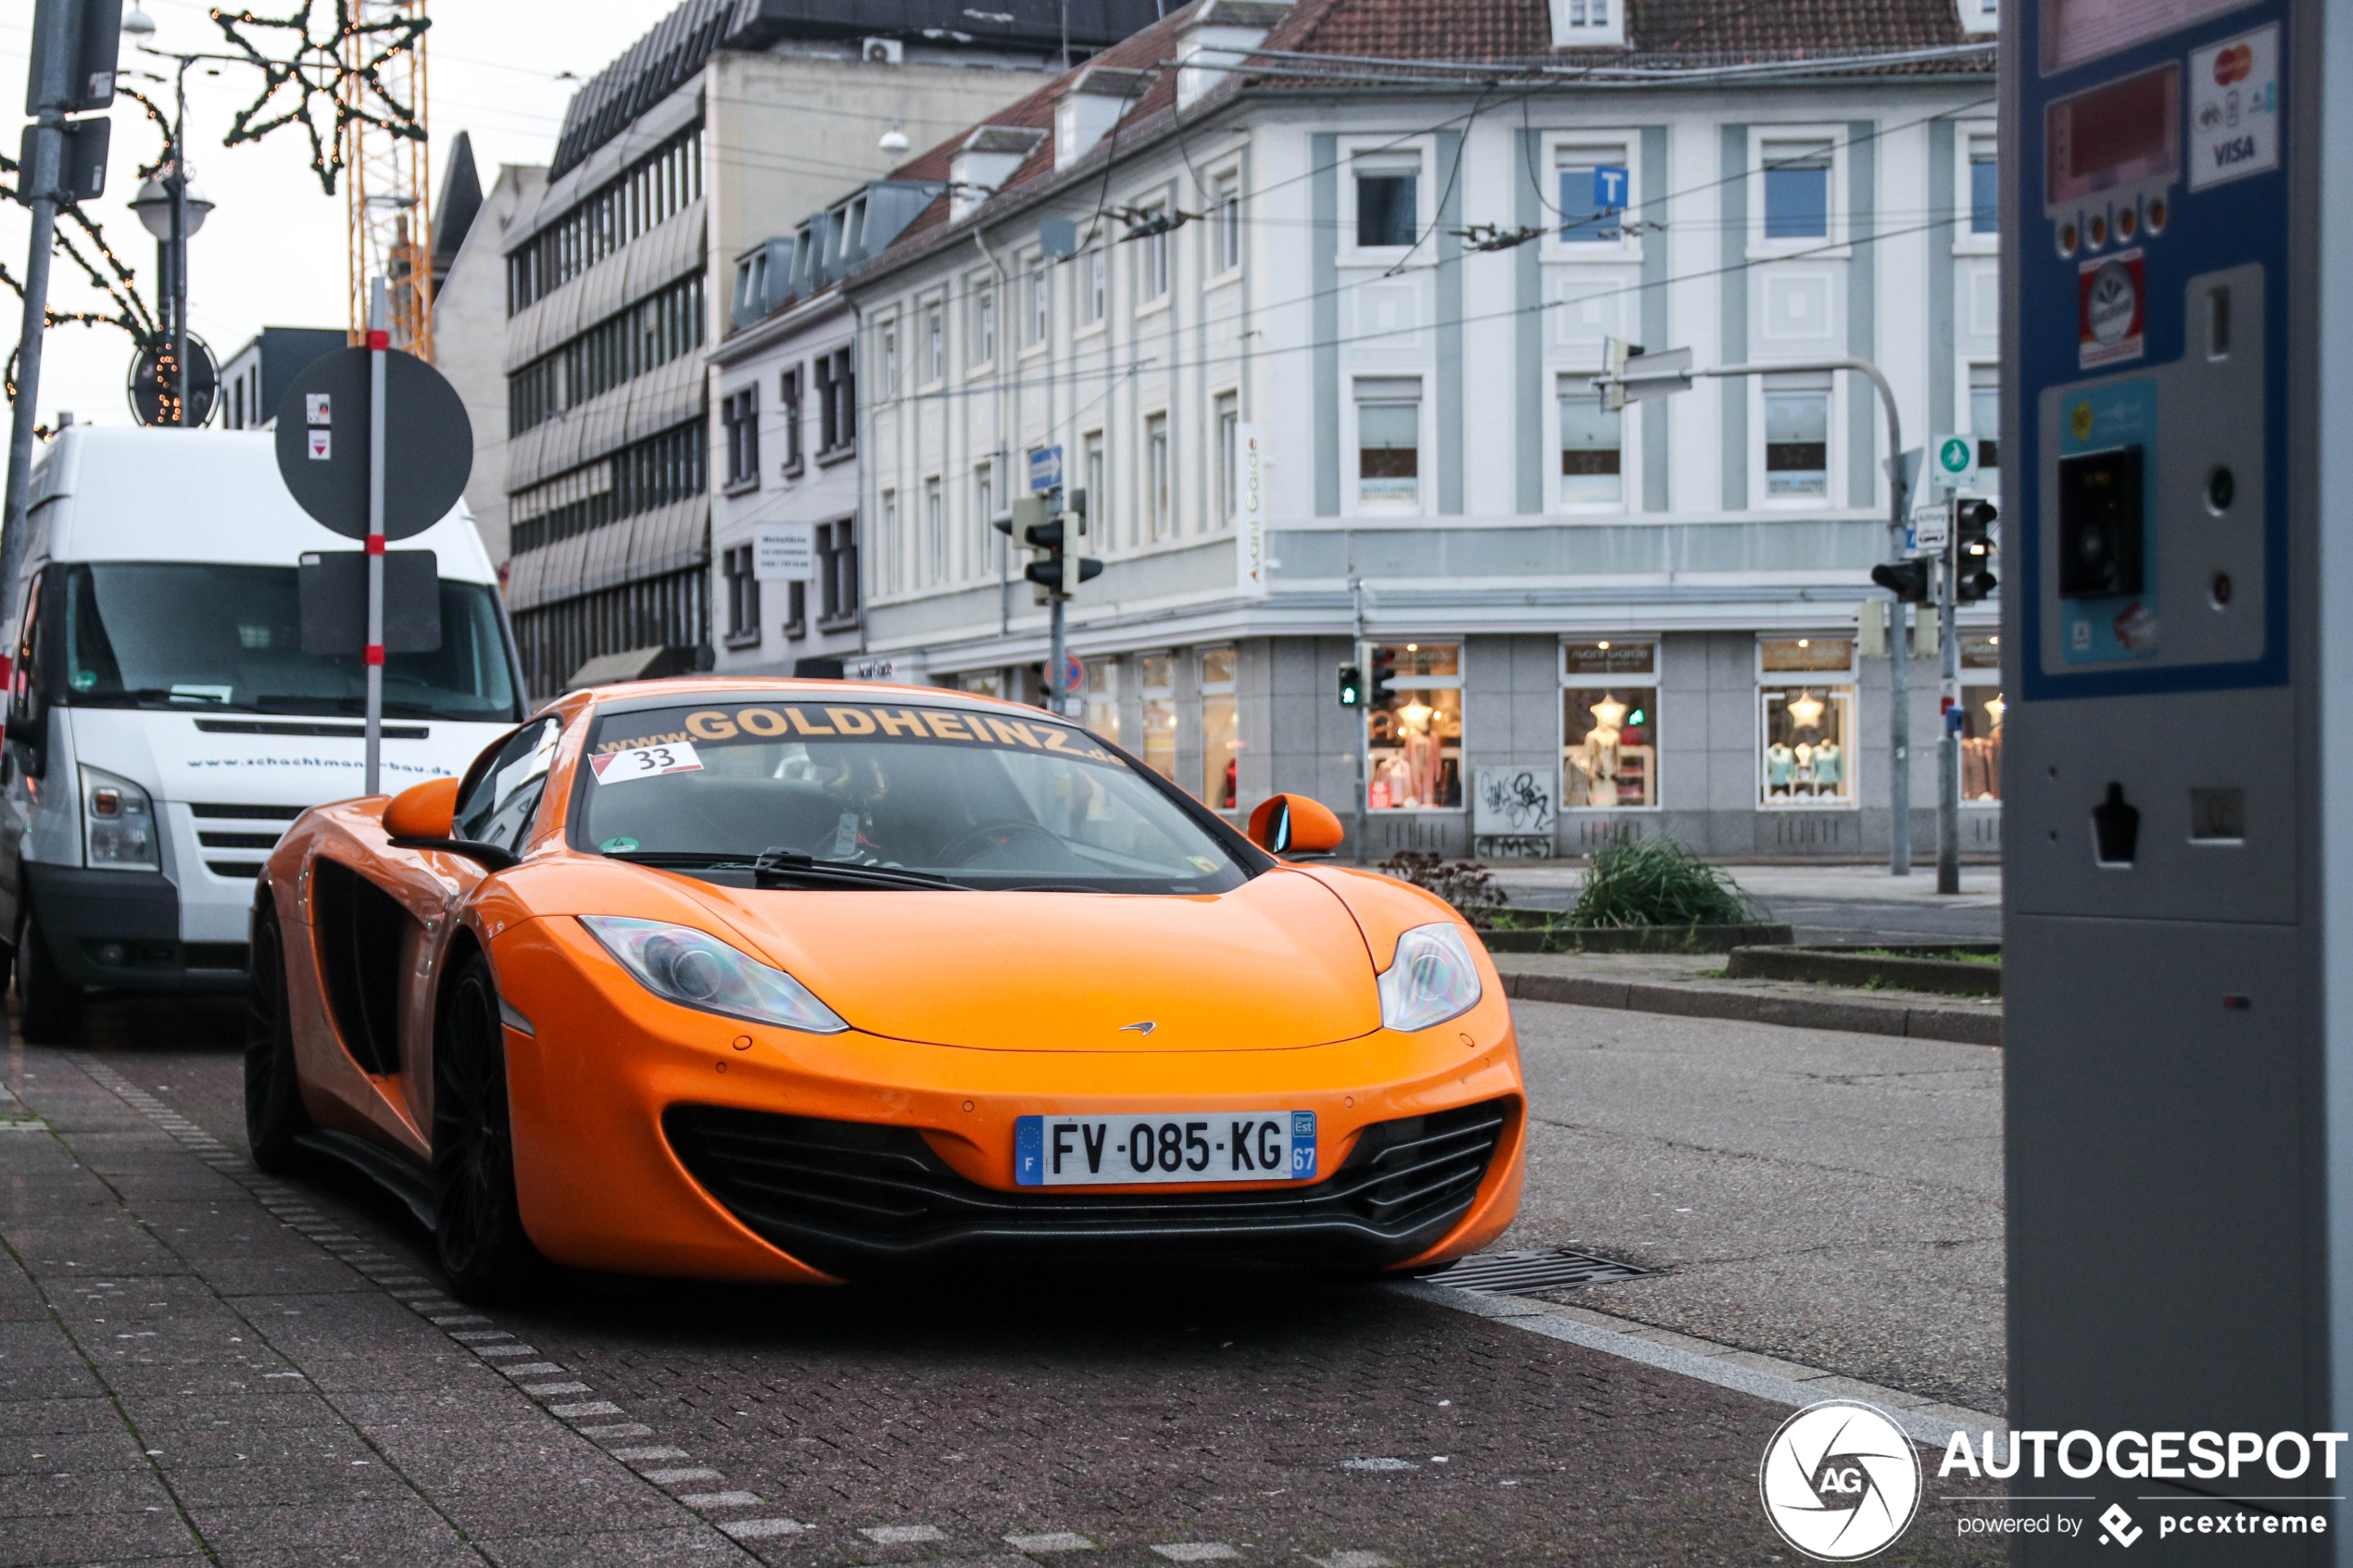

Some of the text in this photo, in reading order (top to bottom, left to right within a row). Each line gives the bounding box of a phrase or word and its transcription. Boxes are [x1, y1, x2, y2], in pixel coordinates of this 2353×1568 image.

[2213, 135, 2255, 167] VISA
[598, 708, 1128, 767] www.GOLDHEINZ.de
[188, 757, 452, 775] www.schachtman-bau.de
[633, 747, 675, 771] 33
[613, 837, 625, 847] 4
[1295, 1122, 1312, 1133] Est
[1025, 1121, 1315, 1174] F FV-085-KG 67
